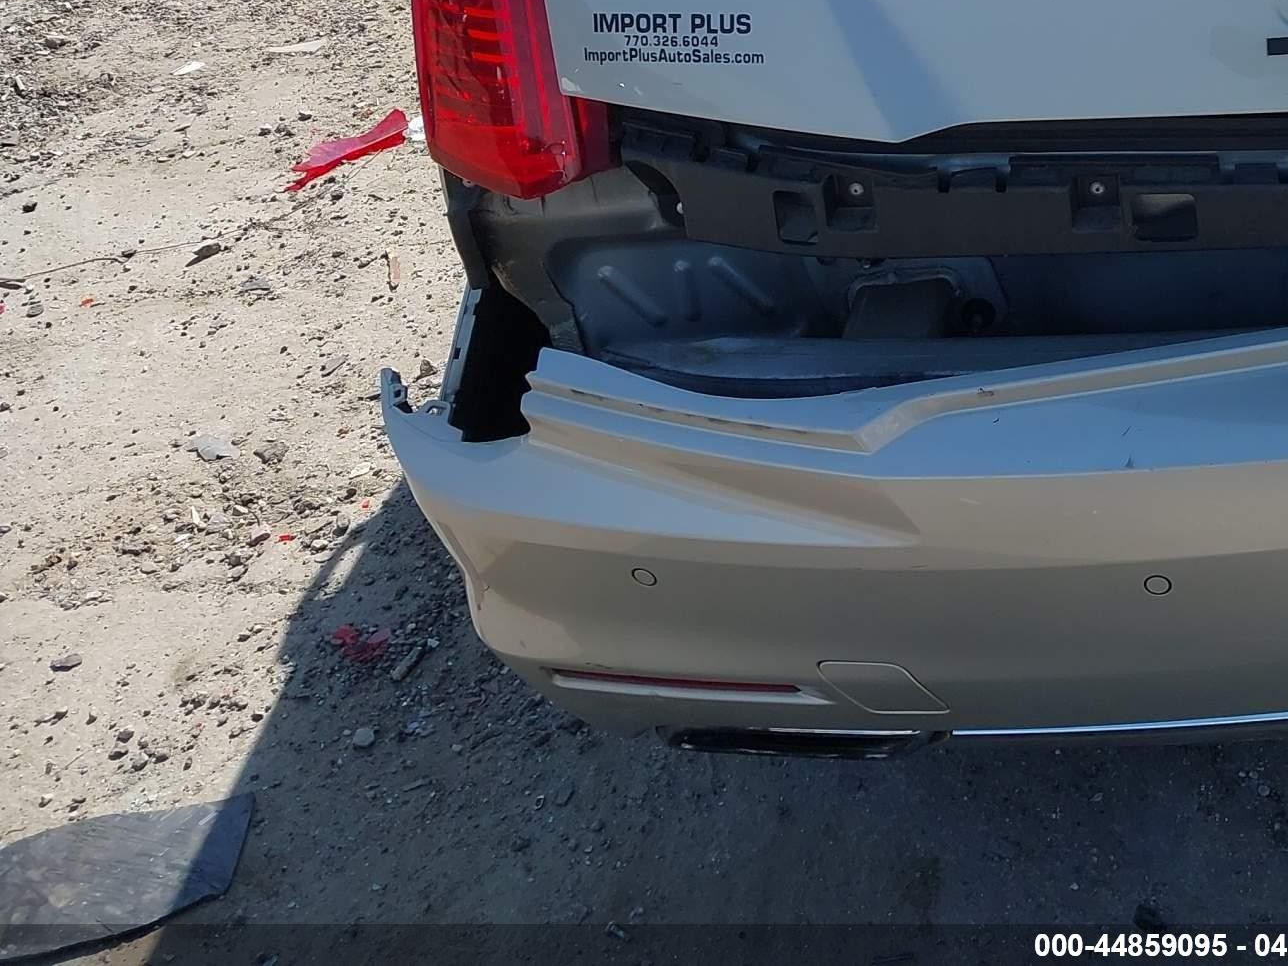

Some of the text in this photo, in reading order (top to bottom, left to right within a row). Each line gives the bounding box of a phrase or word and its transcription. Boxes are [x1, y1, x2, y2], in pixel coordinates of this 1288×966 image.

[592, 13, 752, 35] IMPORT PLUS
[624, 35, 719, 47] 770.326.6044
[584, 47, 765, 65] ImportPlusAutoSales.com
